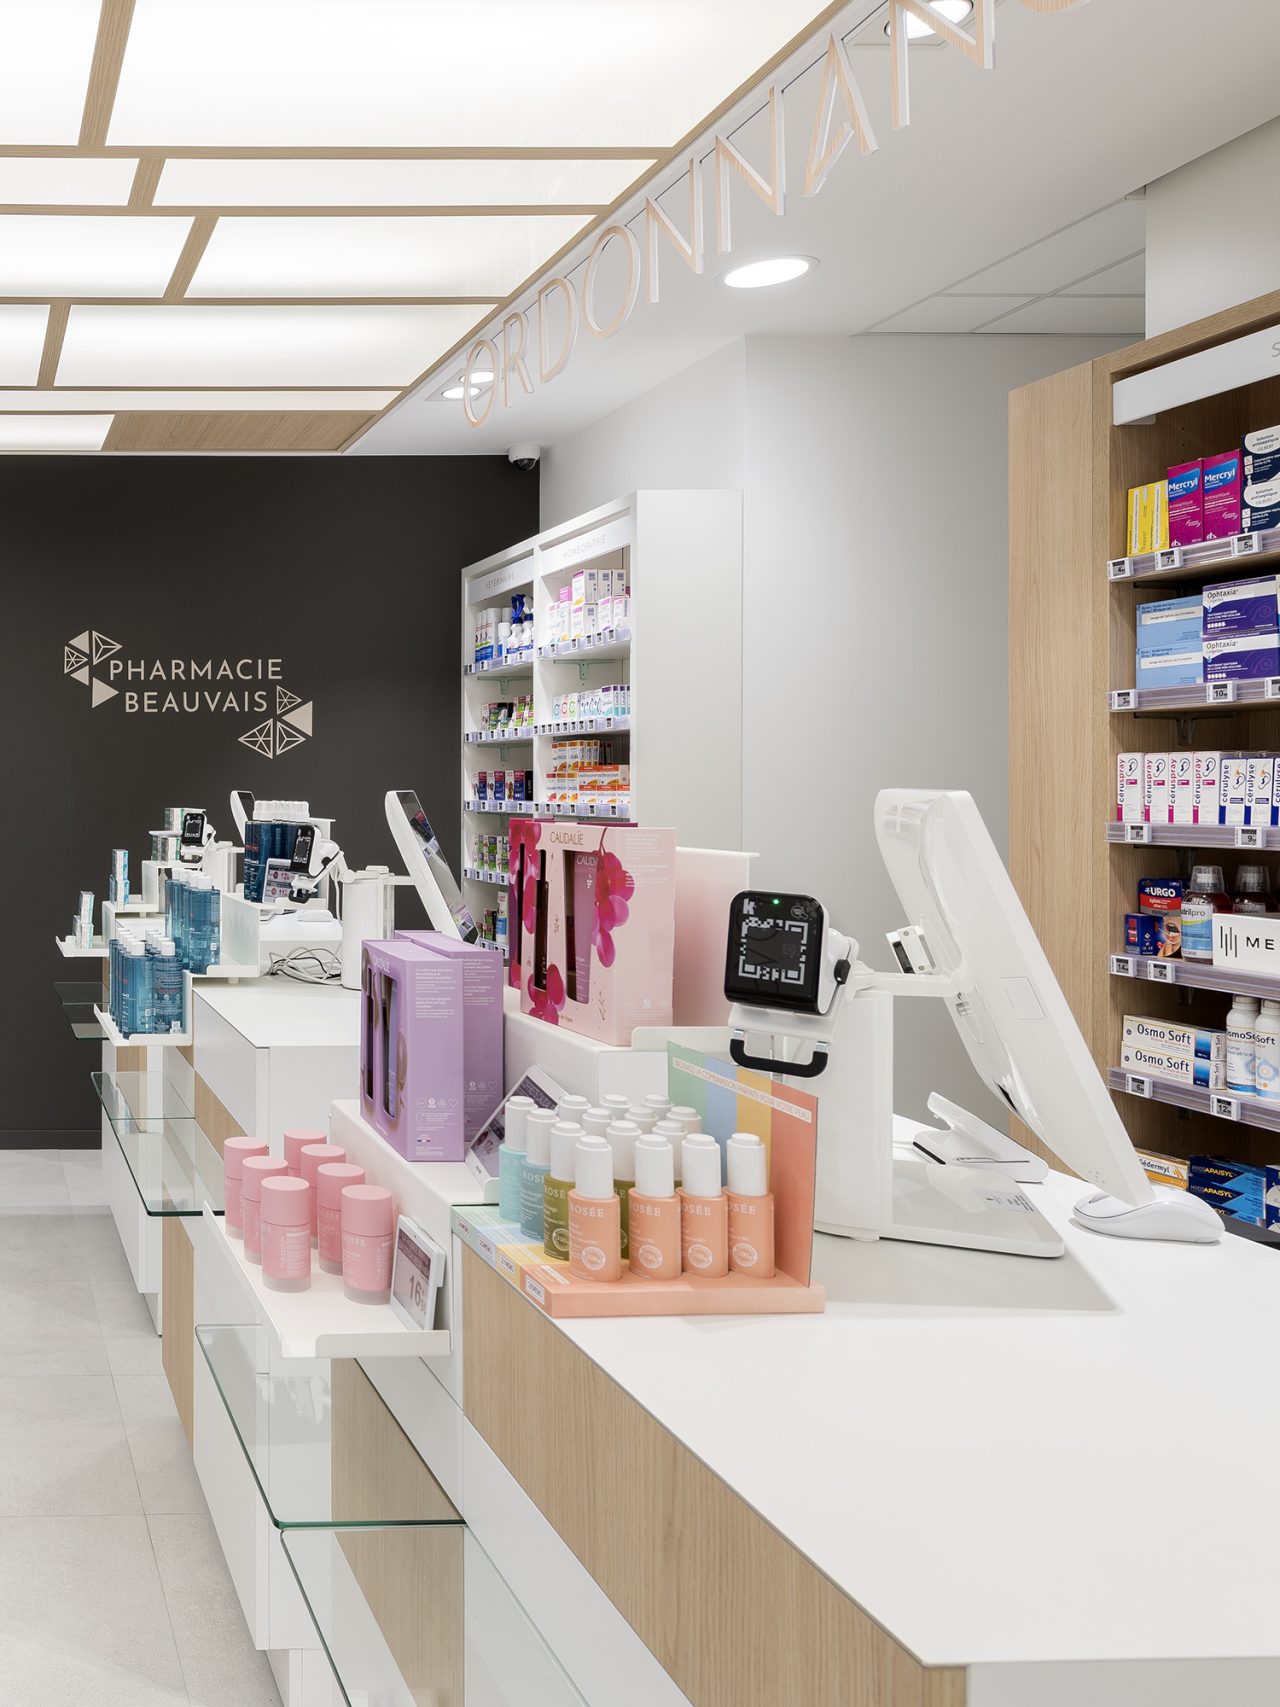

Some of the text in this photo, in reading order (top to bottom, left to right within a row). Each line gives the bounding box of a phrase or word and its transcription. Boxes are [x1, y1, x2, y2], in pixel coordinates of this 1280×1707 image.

[463, 0, 1095, 427] ORDONNAN
[1204, 468, 1236, 483] Mercryl
[1169, 478, 1198, 492] Mercryl
[110, 659, 283, 681] PHARMACIE
[125, 691, 268, 713] BEAUVAIS
[1150, 886, 1176, 898] URGO
[1246, 936, 1275, 950] ME
[1137, 1023, 1191, 1045] Osmo Soft
[1135, 1050, 1190, 1073] Osmo Soft
[1139, 1159, 1170, 1174] Sédermyl
[632, 1202, 662, 1217] OSÉE
[683, 1203, 711, 1216] OSÉE
